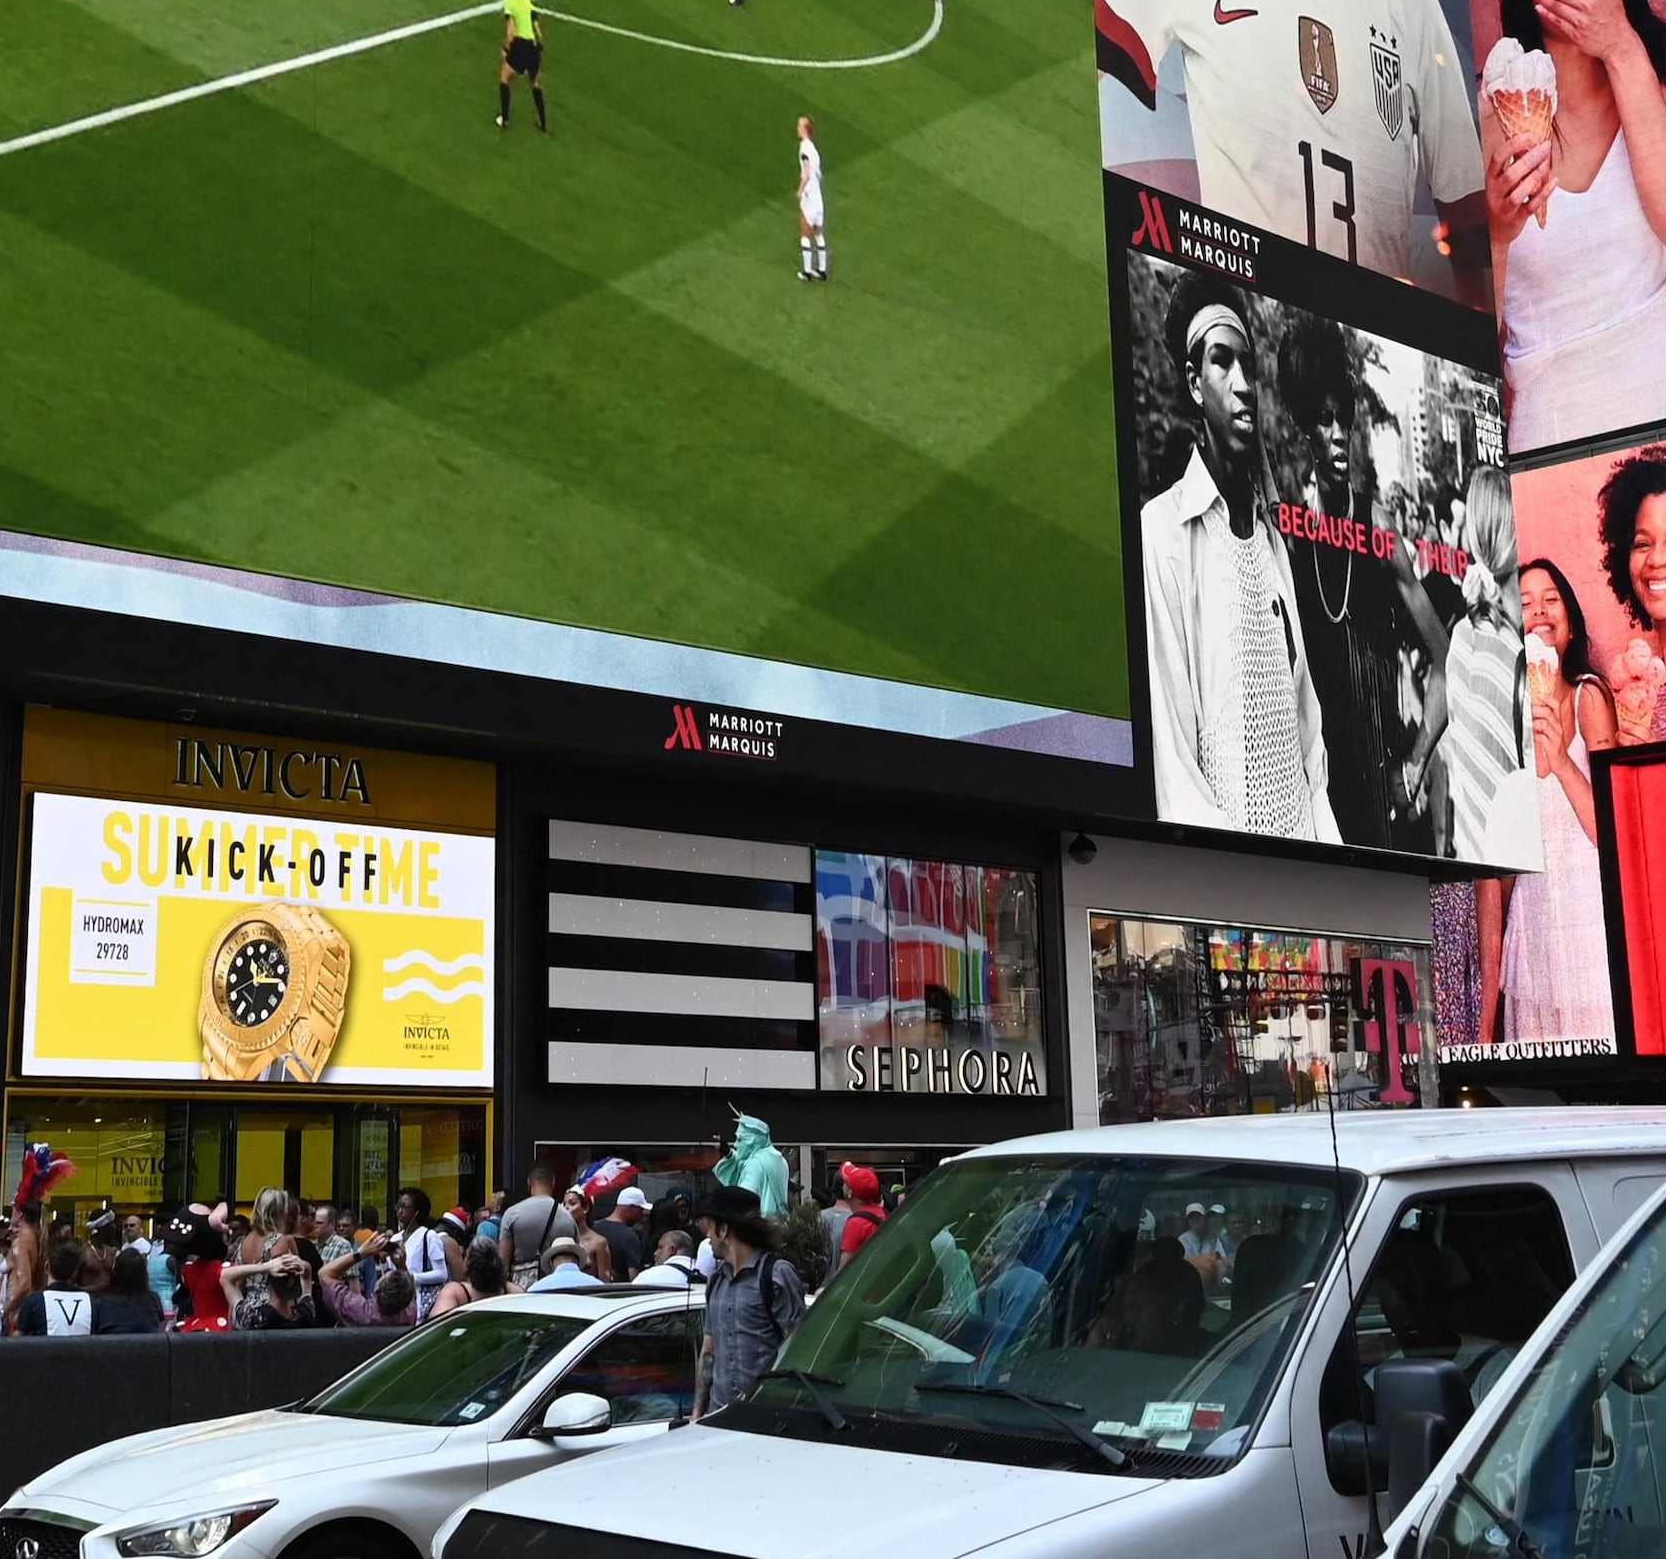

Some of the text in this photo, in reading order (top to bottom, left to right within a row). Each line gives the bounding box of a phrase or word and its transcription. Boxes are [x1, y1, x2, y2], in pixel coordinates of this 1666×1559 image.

[1179, 209, 1261, 254] MARRIOTT
[1180, 238, 1254, 278] MARQUIS
[1476, 427, 1503, 448] PRIDE
[1476, 441, 1505, 468] NYC
[1277, 502, 1368, 554] BECAUSE
[1371, 527, 1397, 561] OF
[709, 712, 783, 737] MARRIOTT
[709, 734, 775, 757] MARQUIS
[171, 736, 372, 806] INVICTA
[175, 835, 377, 891] KICK-OFF
[82, 915, 144, 936] HYDROMAX
[96, 942, 129, 961] 29728
[404, 1026, 450, 1040] INVICTA
[1448, 1042, 1500, 1063] EAGLE
[1505, 1038, 1611, 1060] OUTFITTERS
[845, 1043, 1041, 1097] SEPHORA
[55, 1297, 84, 1329] V
